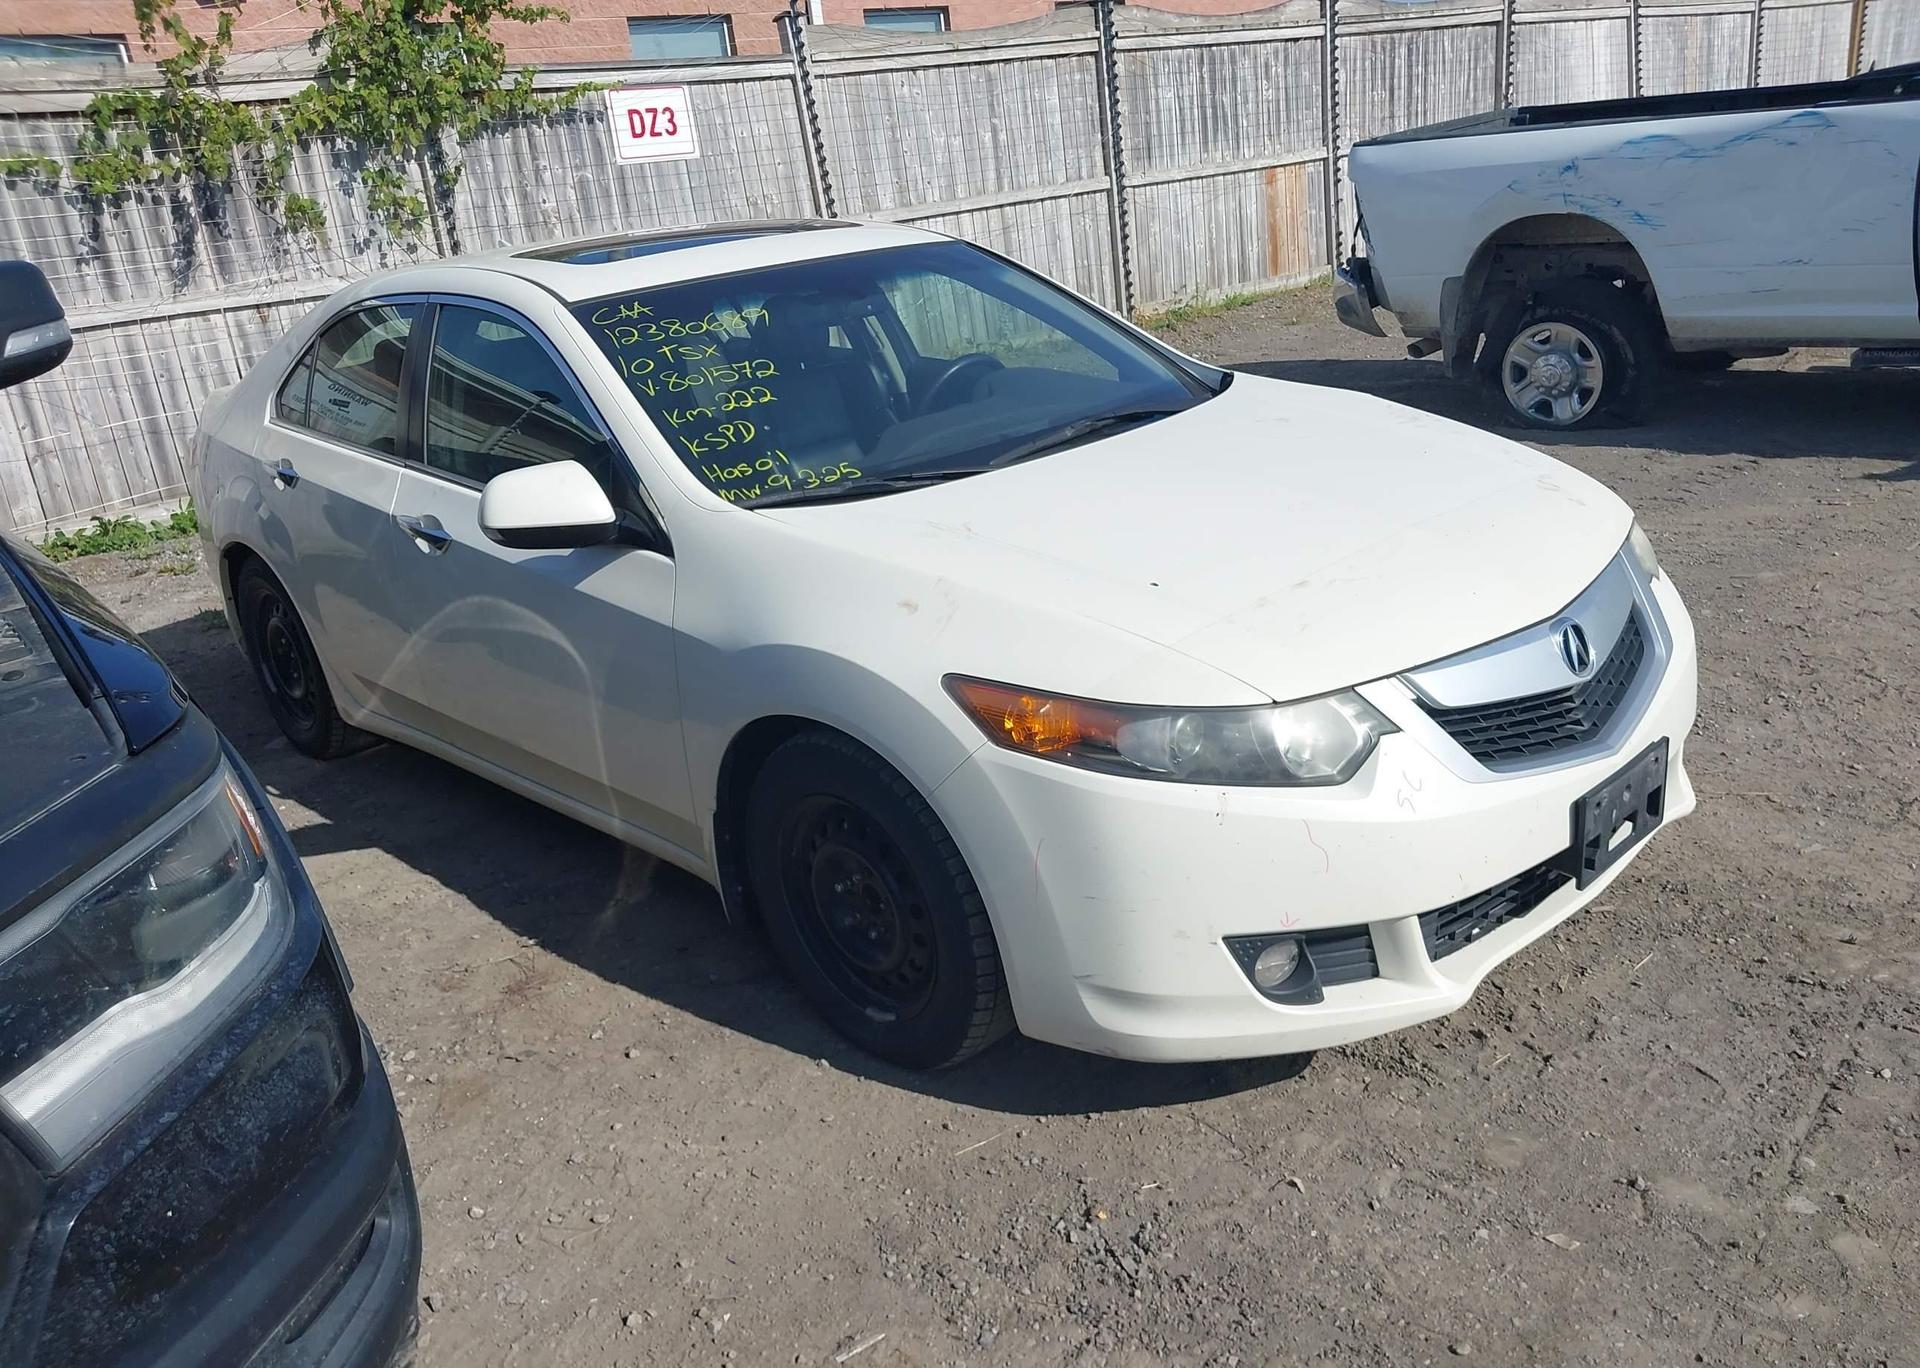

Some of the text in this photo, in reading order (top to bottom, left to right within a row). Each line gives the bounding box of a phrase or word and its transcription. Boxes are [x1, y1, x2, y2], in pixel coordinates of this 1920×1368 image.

[627, 106, 678, 138] DZ3
[592, 301, 654, 325] CAA
[618, 344, 721, 378] 10 TSX
[680, 420, 755, 459] KSPD
